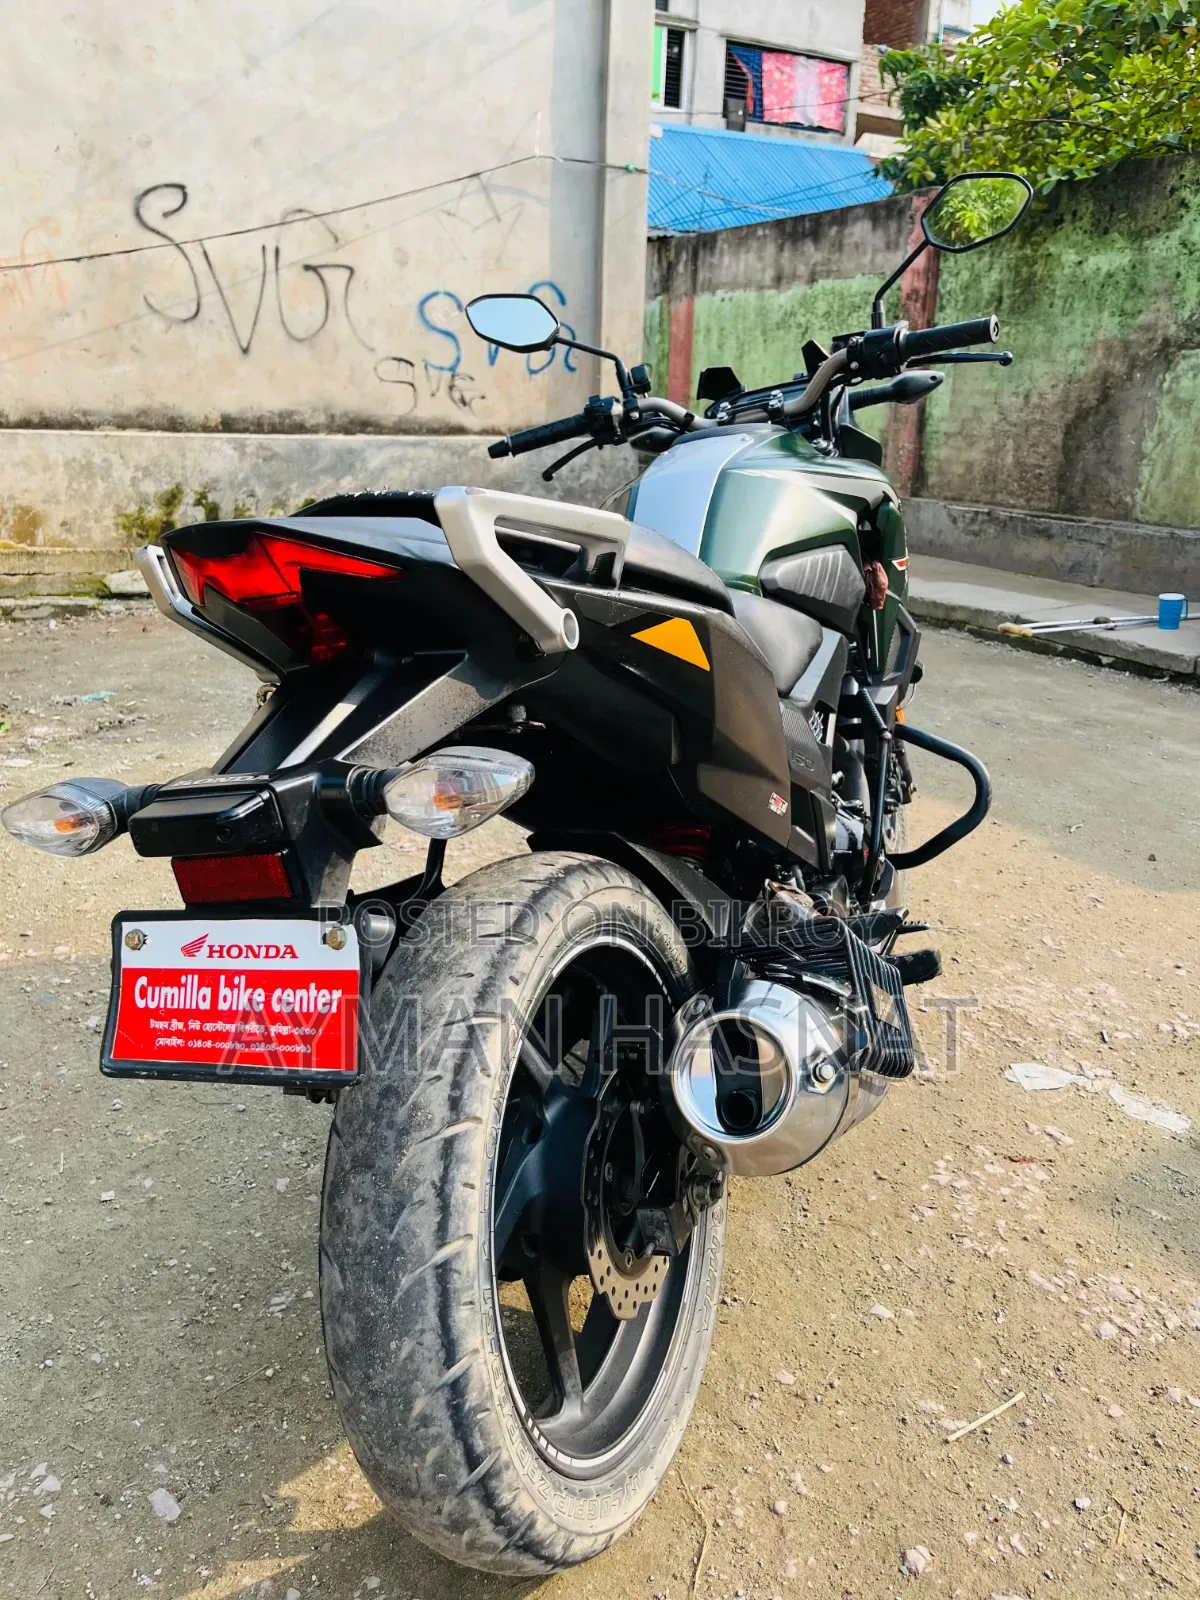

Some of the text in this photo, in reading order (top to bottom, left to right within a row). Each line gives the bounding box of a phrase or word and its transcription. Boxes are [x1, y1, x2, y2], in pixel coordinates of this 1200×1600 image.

[207, 944, 299, 960] HONDA
[134, 974, 342, 1014] Cumilla bike center
